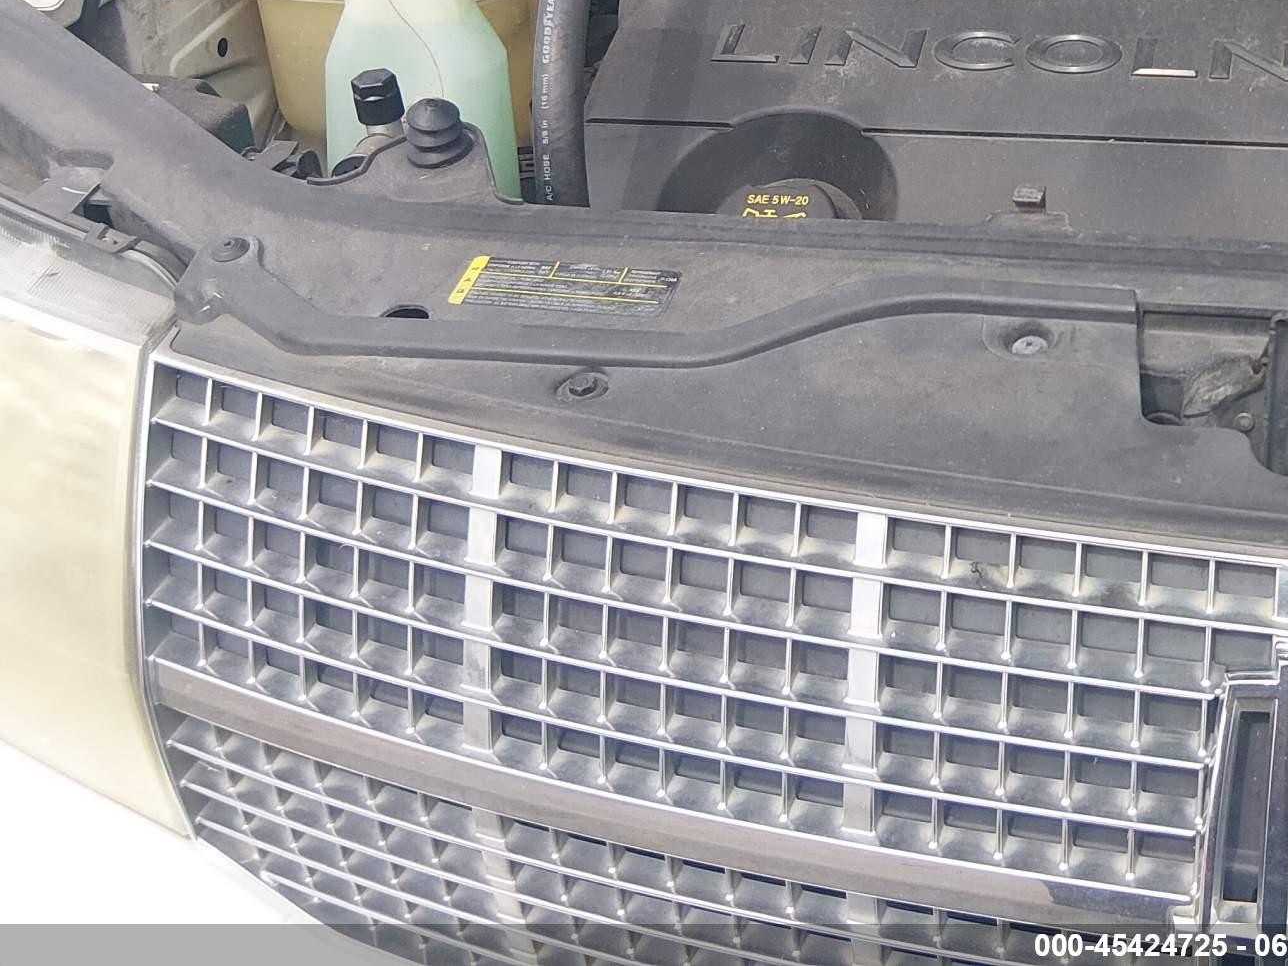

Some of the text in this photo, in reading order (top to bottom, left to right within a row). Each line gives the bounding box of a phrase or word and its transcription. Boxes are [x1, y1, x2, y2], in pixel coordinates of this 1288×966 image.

[543, 153, 553, 181] HOSE
[545, 185, 554, 202] A/C
[747, 194, 809, 206] SAE 5W-20
